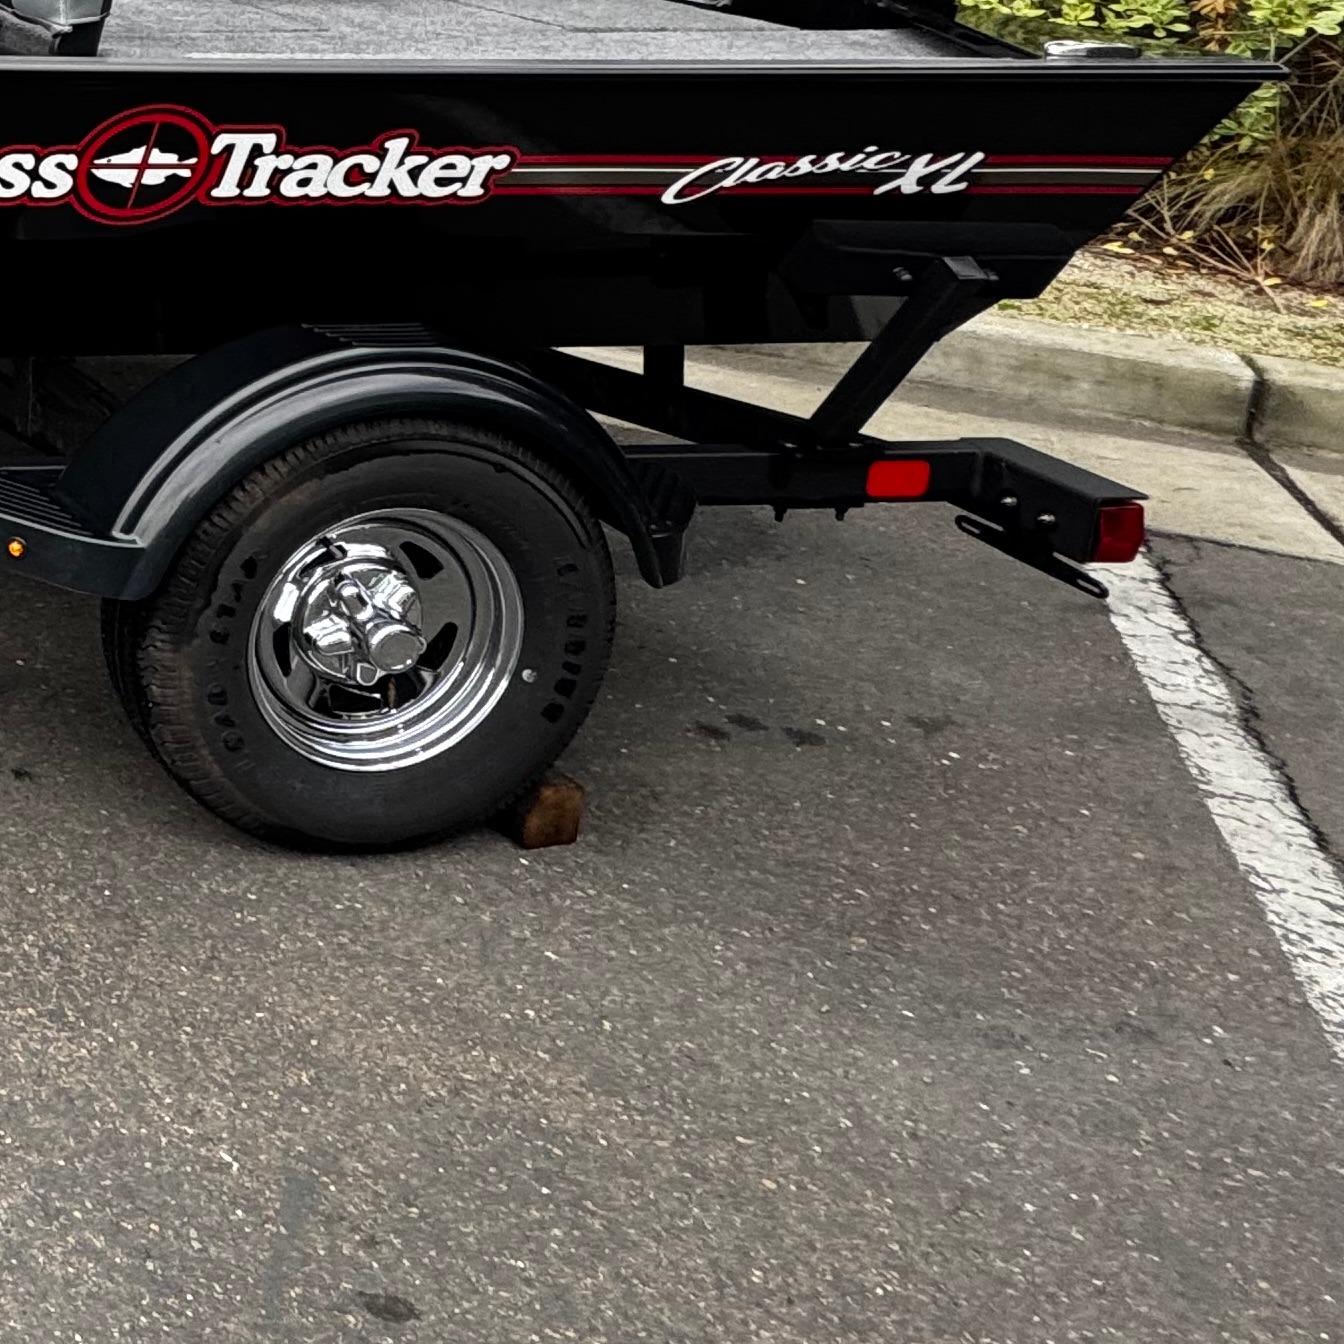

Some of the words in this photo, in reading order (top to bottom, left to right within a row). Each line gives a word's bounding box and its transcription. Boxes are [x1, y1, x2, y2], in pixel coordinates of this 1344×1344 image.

[210, 132, 512, 199] Tracker
[660, 145, 911, 206] Classic
[872, 151, 986, 196] XL
